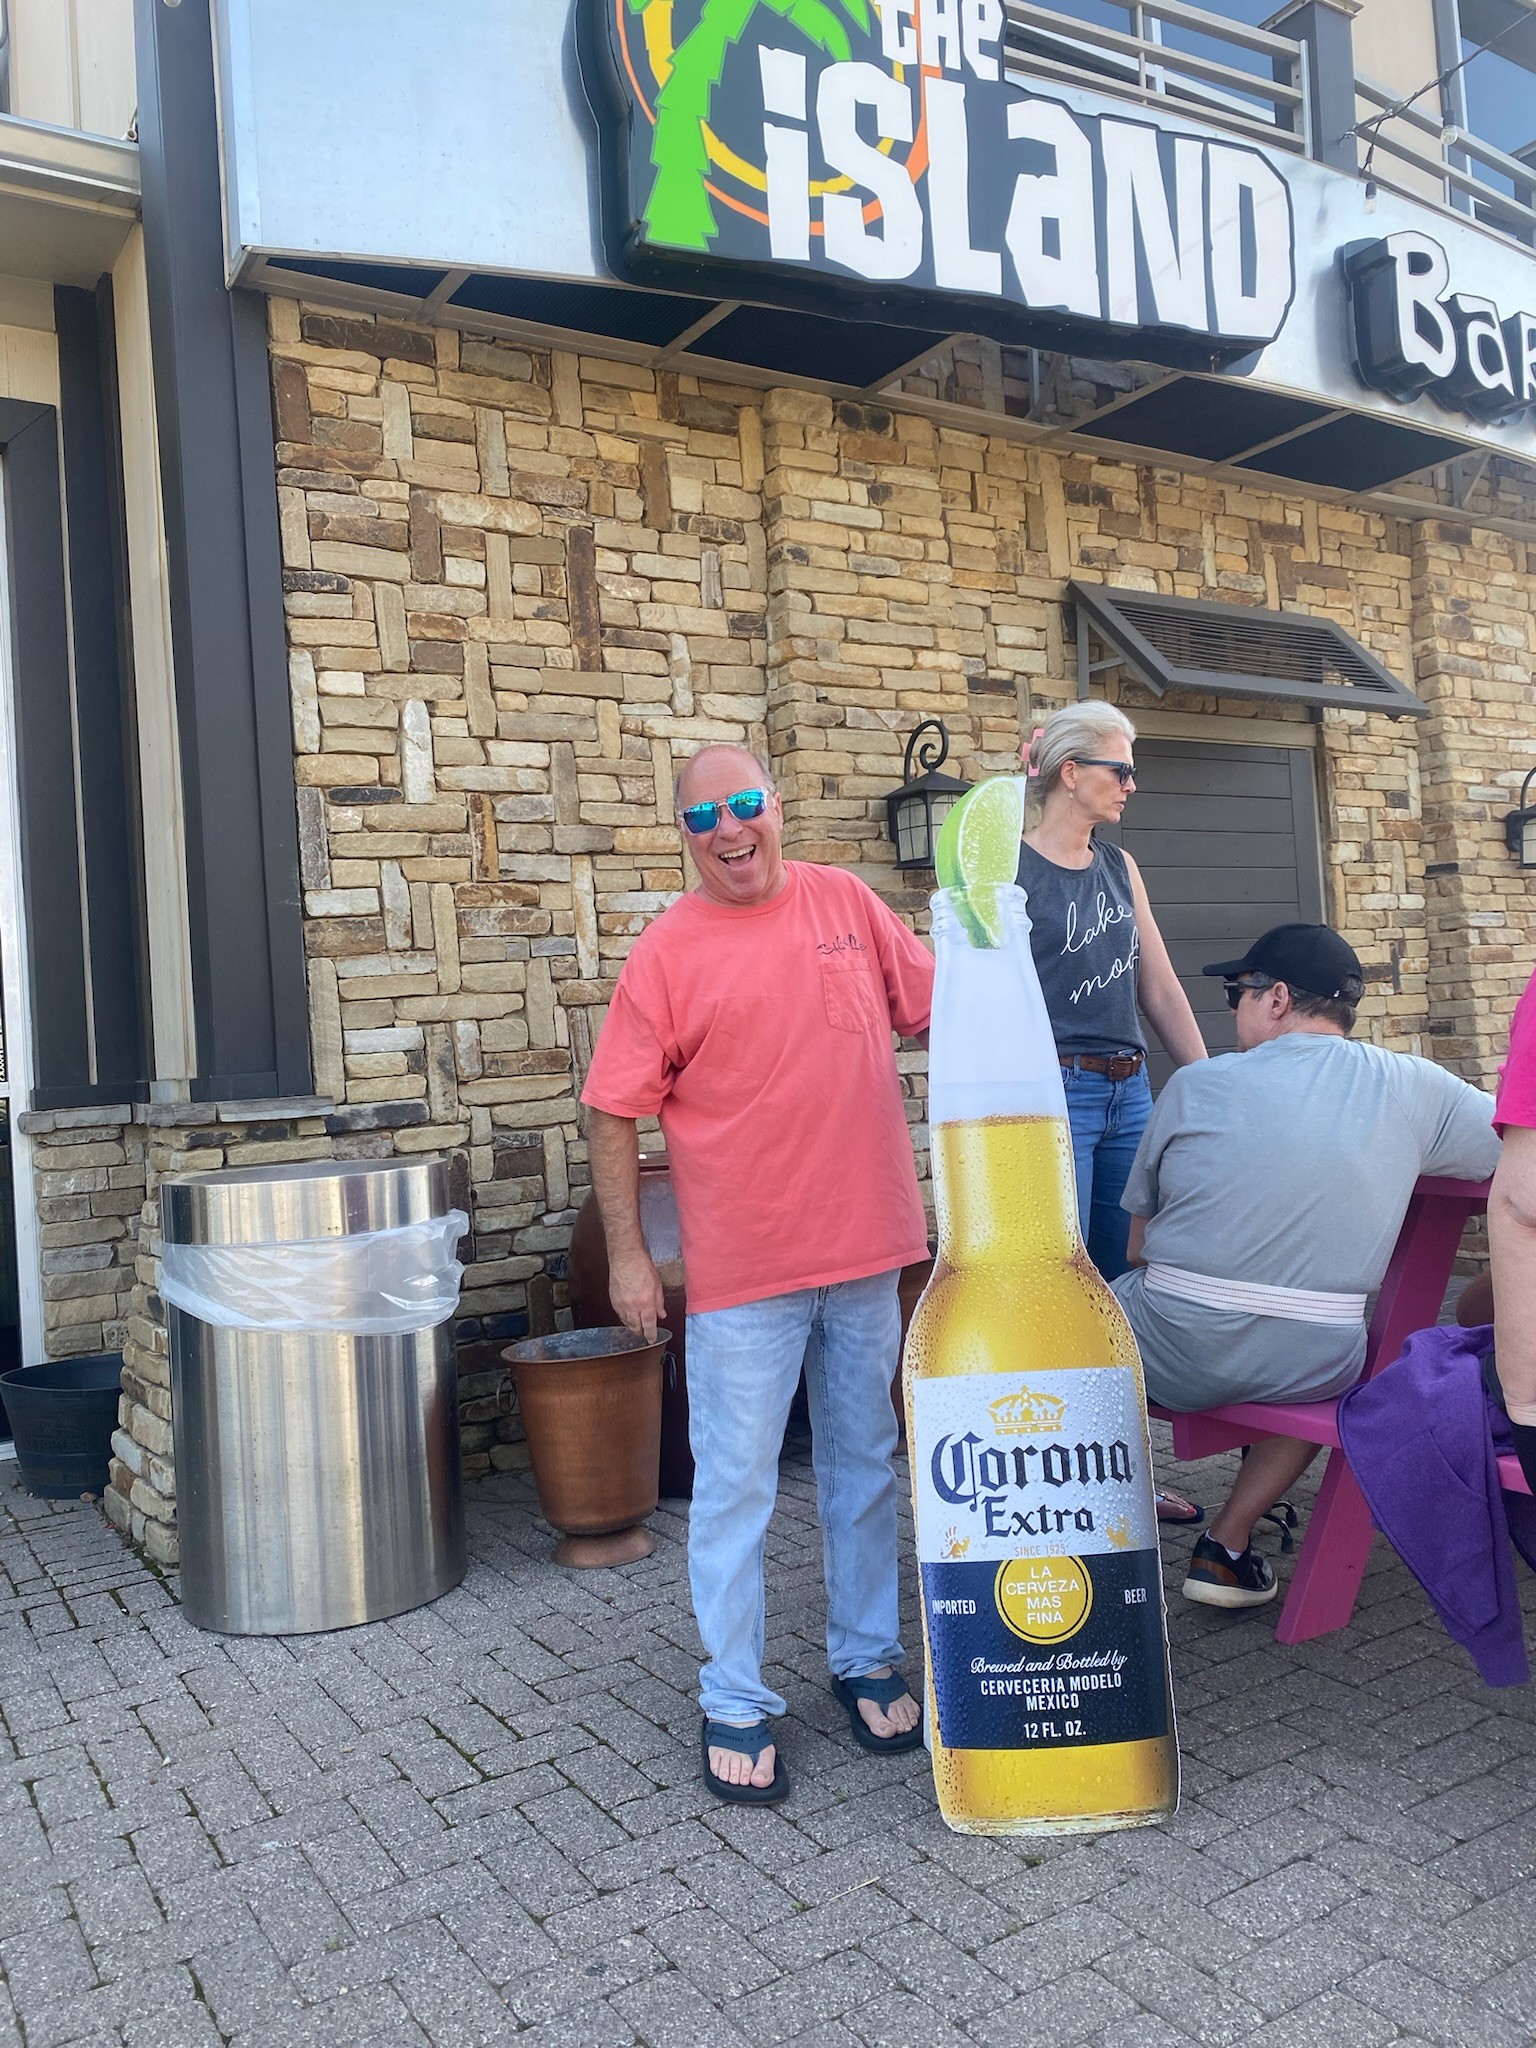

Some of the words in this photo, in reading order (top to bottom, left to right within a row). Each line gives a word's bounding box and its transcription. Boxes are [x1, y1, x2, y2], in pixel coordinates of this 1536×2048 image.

[1060, 891, 1132, 955] lake
[1069, 926, 1139, 1004] mod
[931, 1431, 1134, 1512] Corona
[981, 1495, 1096, 1538] Extra
[1014, 1545, 1041, 1557] SINCE
[1045, 1544, 1067, 1555] 1925
[1030, 1565, 1052, 1579] LA
[1005, 1579, 1080, 1596] CERVEZA
[1124, 1587, 1148, 1605] BEER
[931, 1599, 977, 1616] IMPORTED
[1026, 1595, 1062, 1610] MAS
[1026, 1611, 1065, 1626] FINA
[970, 1656, 1026, 1675] Brewed
[1025, 1654, 1055, 1673] and
[1056, 1650, 1112, 1671] Bottled
[1110, 1649, 1128, 1672] by
[980, 1677, 1066, 1697] CERVECERIA
[1069, 1672, 1122, 1692] MODELO
[1026, 1693, 1080, 1712] MEXICO
[1023, 1722, 1039, 1739] 12
[1042, 1722, 1062, 1738] FL.
[1065, 1720, 1087, 1737] OZ.
